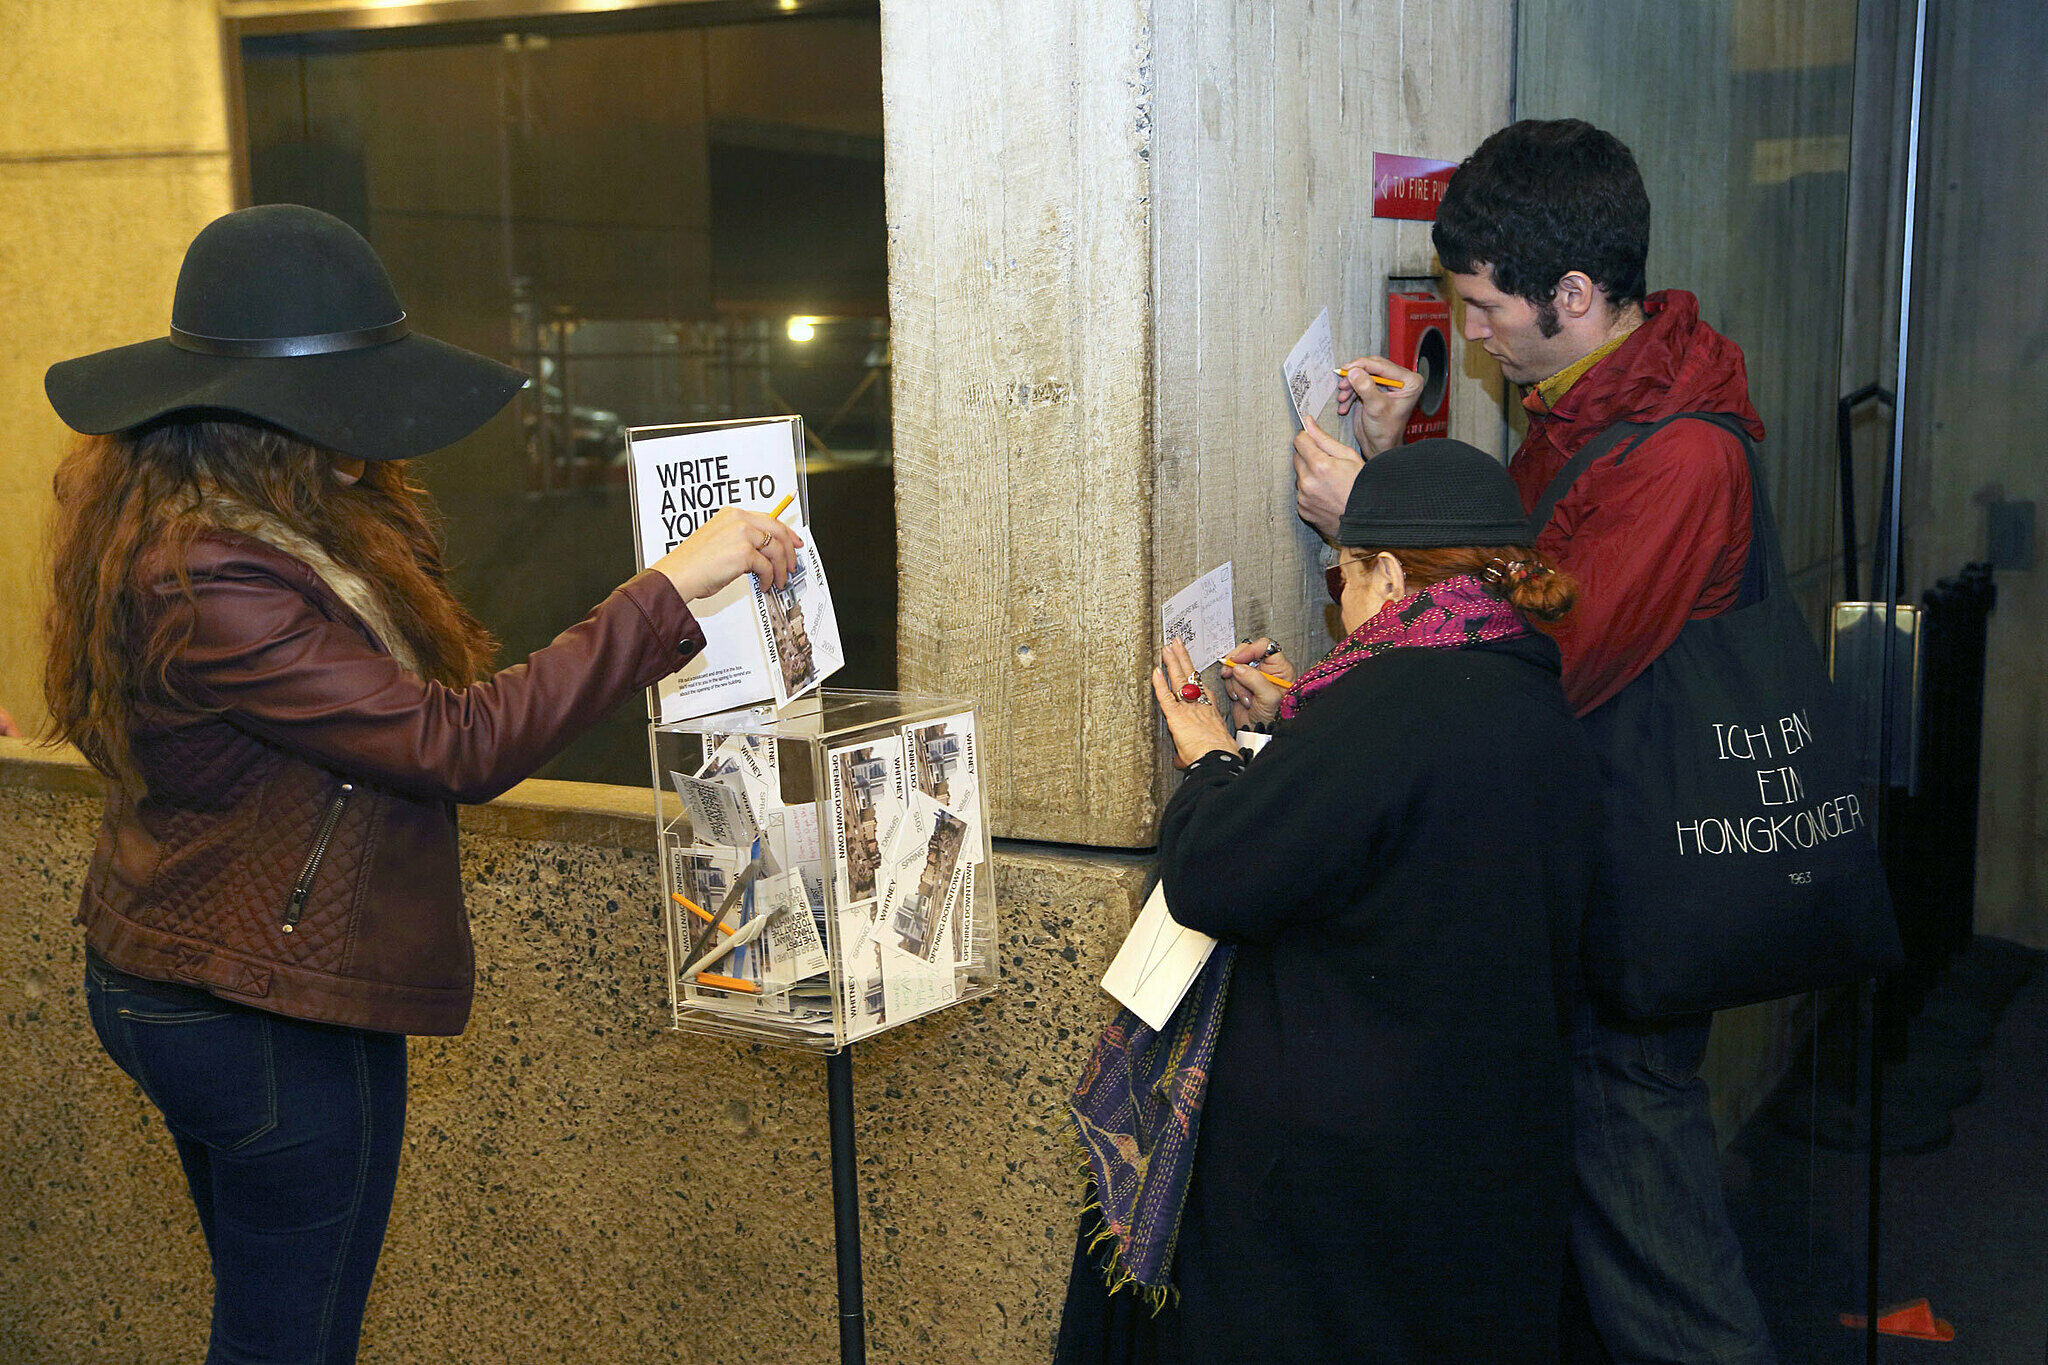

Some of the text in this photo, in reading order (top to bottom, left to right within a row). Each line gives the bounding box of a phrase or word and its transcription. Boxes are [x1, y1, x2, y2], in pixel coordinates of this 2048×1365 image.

[1393, 175, 1449, 202] TO FIRE PU
[656, 455, 730, 488] WRITE
[661, 474, 775, 515] A NOTE TO
[808, 547, 824, 587] WHITNEY
[760, 609, 777, 663] DOWNTOWN
[810, 602, 823, 636] SPRING
[741, 744, 762, 778] WHITNEY
[768, 737, 776, 769] HITNEY
[907, 730, 917, 774] OPENING
[966, 732, 975, 775] WHITNEY
[1712, 723, 1773, 760] ICH
[894, 756, 904, 801] WHITNEY
[1757, 767, 1805, 805] EIN
[831, 754, 847, 860] OPENING DOWNTOWN
[1676, 794, 1865, 856] HONGKONGER
[881, 815, 899, 848] SPRING
[902, 847, 925, 870] SPRING
[1788, 871, 1812, 885] 1963
[879, 878, 896, 921] WHITNEY
[964, 861, 972, 919] DOWNTOWN
[679, 905, 691, 953] OWNTOWN
[929, 867, 962, 964] OPENING DOWNTOWN
[963, 919, 971, 962] OPENING
[847, 975, 857, 1019] WHITNEY
